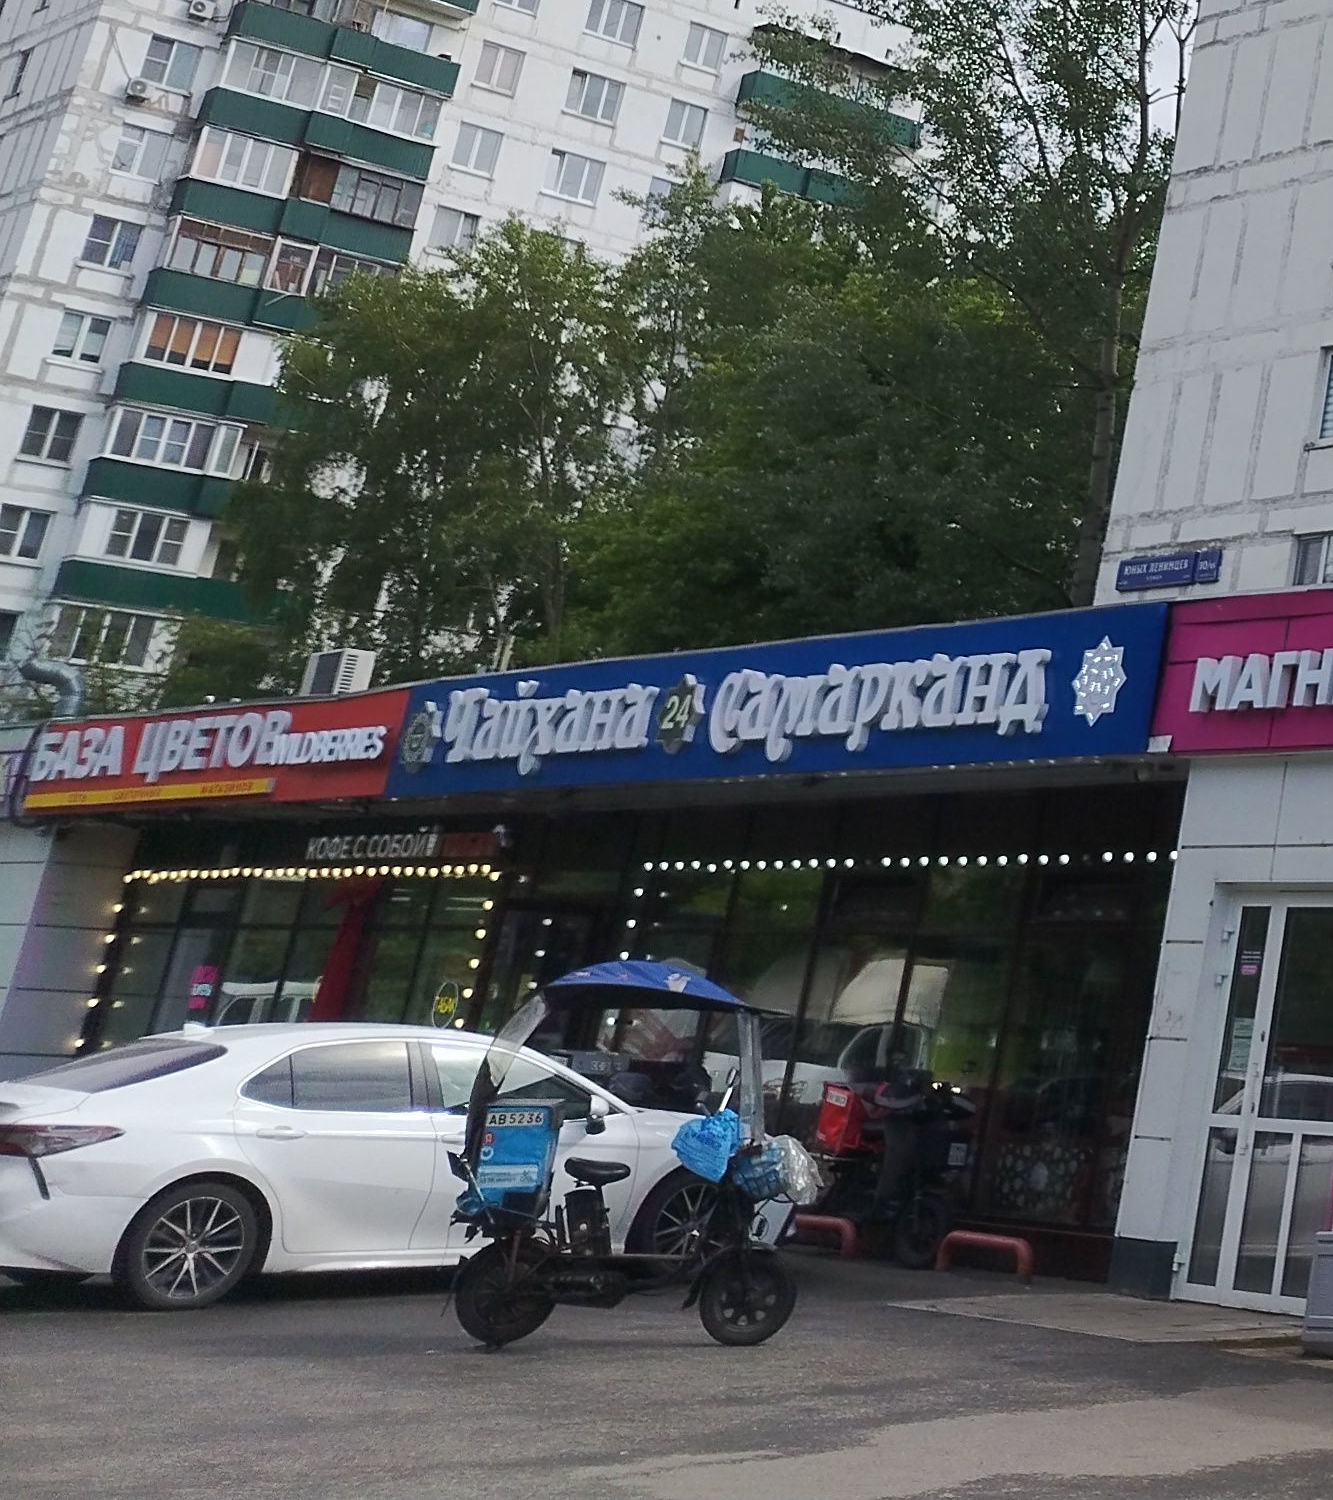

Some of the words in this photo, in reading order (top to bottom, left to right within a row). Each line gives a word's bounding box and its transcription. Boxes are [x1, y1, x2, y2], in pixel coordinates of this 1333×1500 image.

[1124, 563, 1148, 576] ЮНЫХ
[1148, 559, 1189, 573] ЛЕНИНЦЕВ
[442, 680, 661, 776] Чайхана
[661, 696, 691, 730] 24
[708, 648, 1053, 763] Самарканд
[29, 724, 126, 783] БАЗА
[133, 710, 292, 784] ЦВЕТОВ
[271, 726, 391, 766] WILDBERRIES
[305, 835, 352, 860] КОФЕ
[352, 834, 367, 858] С
[367, 825, 428, 858] СОБОЙ
